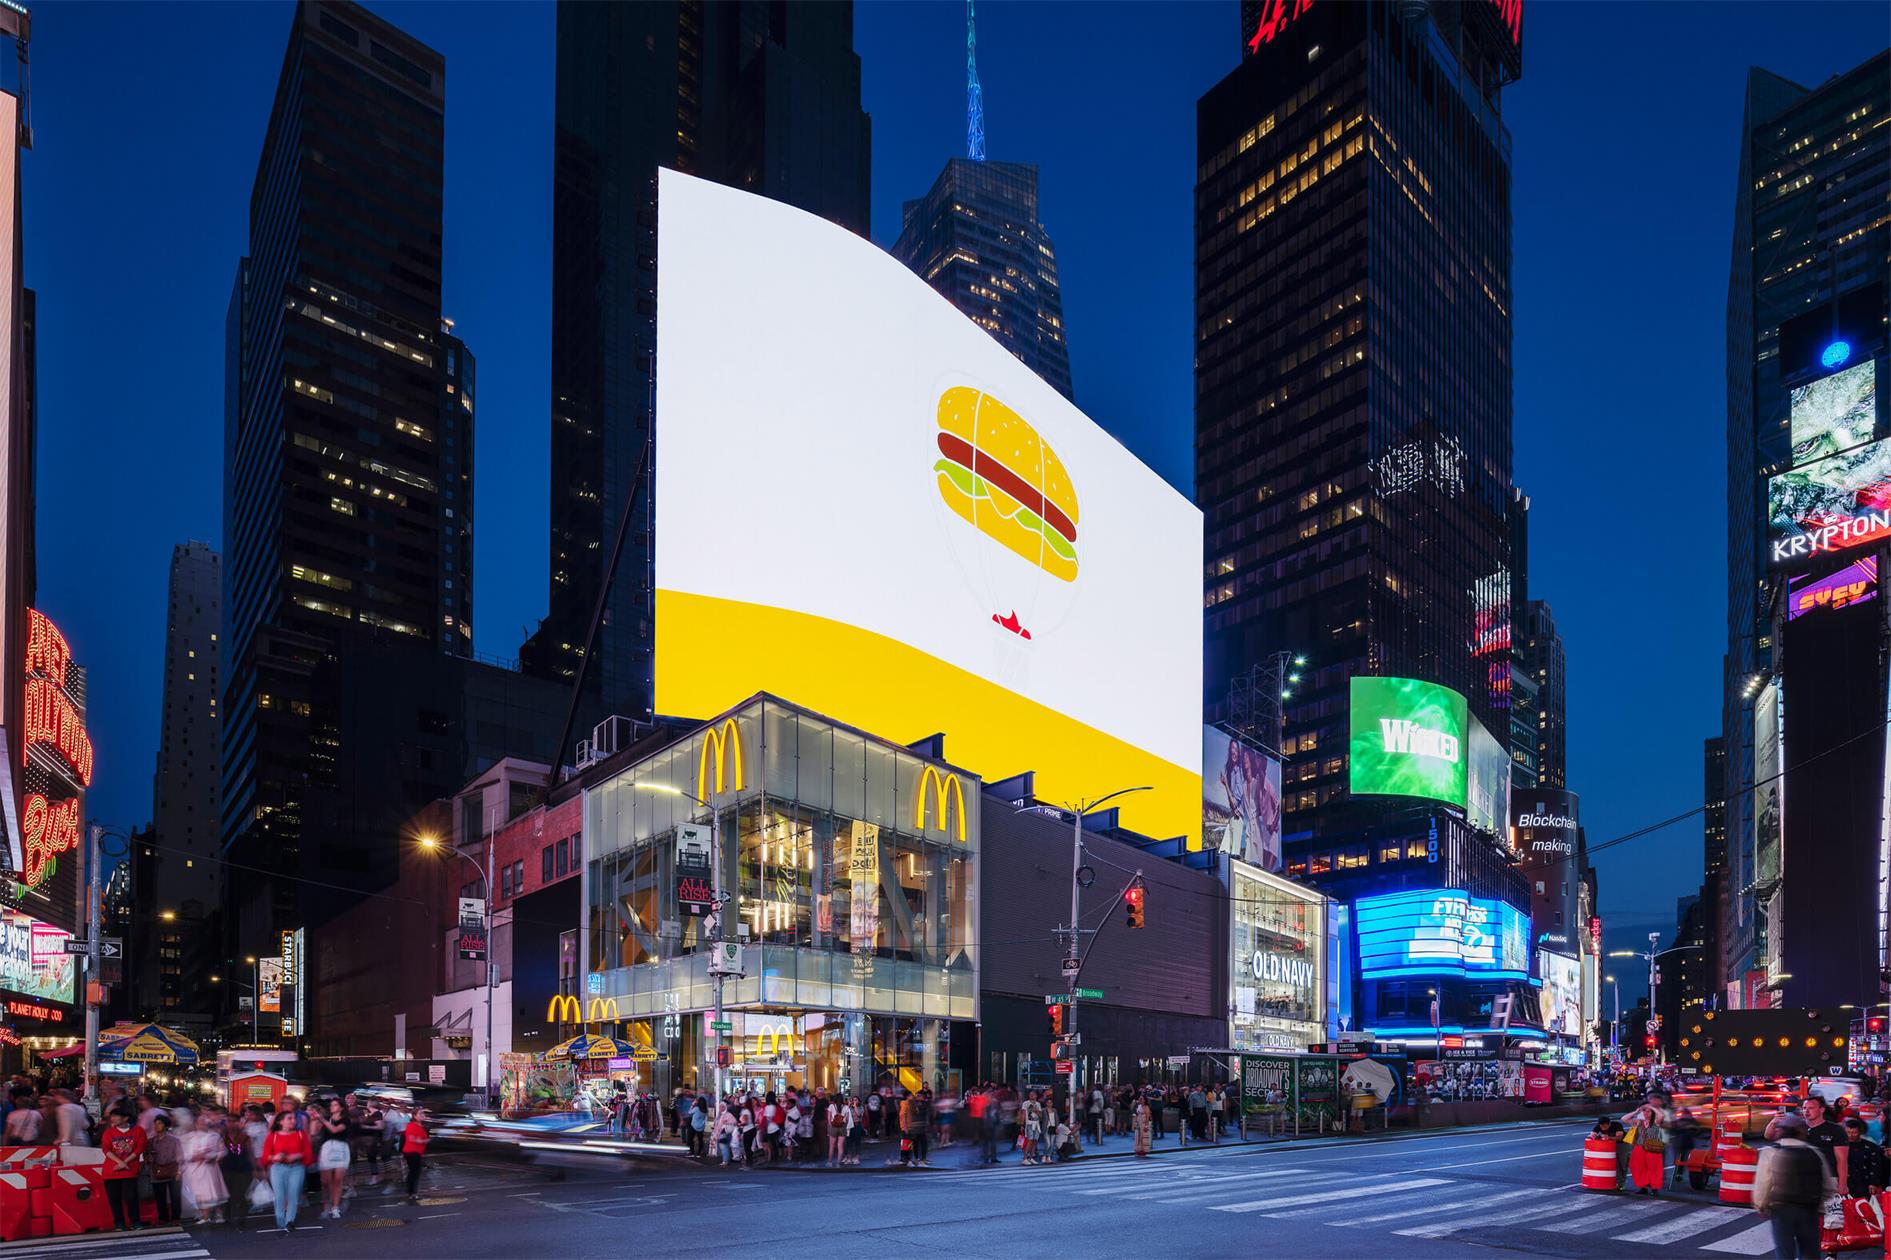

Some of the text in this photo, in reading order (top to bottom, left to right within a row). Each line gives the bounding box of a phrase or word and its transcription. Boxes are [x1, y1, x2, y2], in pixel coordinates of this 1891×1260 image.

[1773, 508, 1891, 562] KRYPTON
[26, 679, 93, 787] OLLYWOOD
[1518, 813, 1577, 832] Blockchain
[1427, 817, 1439, 863] 1500
[1532, 838, 1572, 855] making
[680, 877, 708, 891] ALL
[679, 887, 711, 902] RISE
[460, 941, 485, 950] RISE
[462, 933, 482, 943] ALL
[1548, 934, 1567, 944] Nasdaq
[1252, 950, 1314, 988] OLD NAVY
[1082, 989, 1103, 999] Broadway
[10, 1001, 62, 1021] PLANET HOLLYOOD
[127, 1052, 172, 1060] SABRETT
[1246, 1060, 1290, 1069] DISCOVER
[1245, 1068, 1290, 1090] BROADWAY'S
[1245, 1087, 1290, 1099] SECRS
